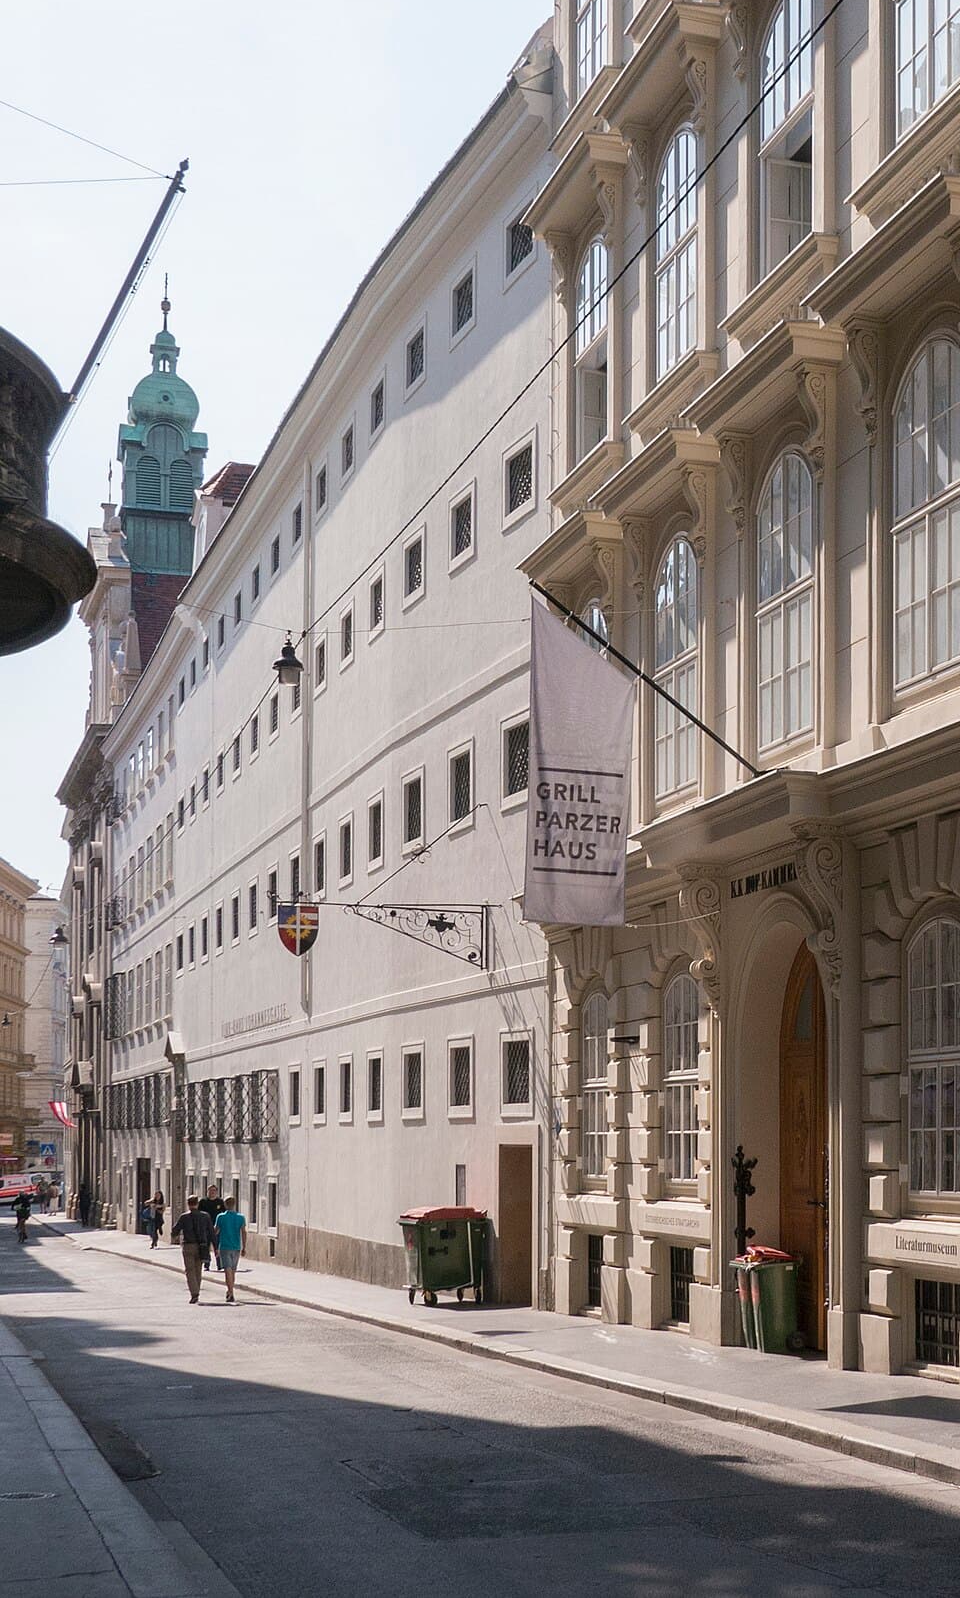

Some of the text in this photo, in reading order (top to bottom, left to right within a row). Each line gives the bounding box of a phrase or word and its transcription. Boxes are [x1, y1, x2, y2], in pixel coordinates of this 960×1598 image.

[536, 781, 601, 804] GRILL
[535, 810, 621, 834] PARZER
[533, 839, 597, 860] HAUS
[895, 1235, 958, 1257] Literaturmuseum
